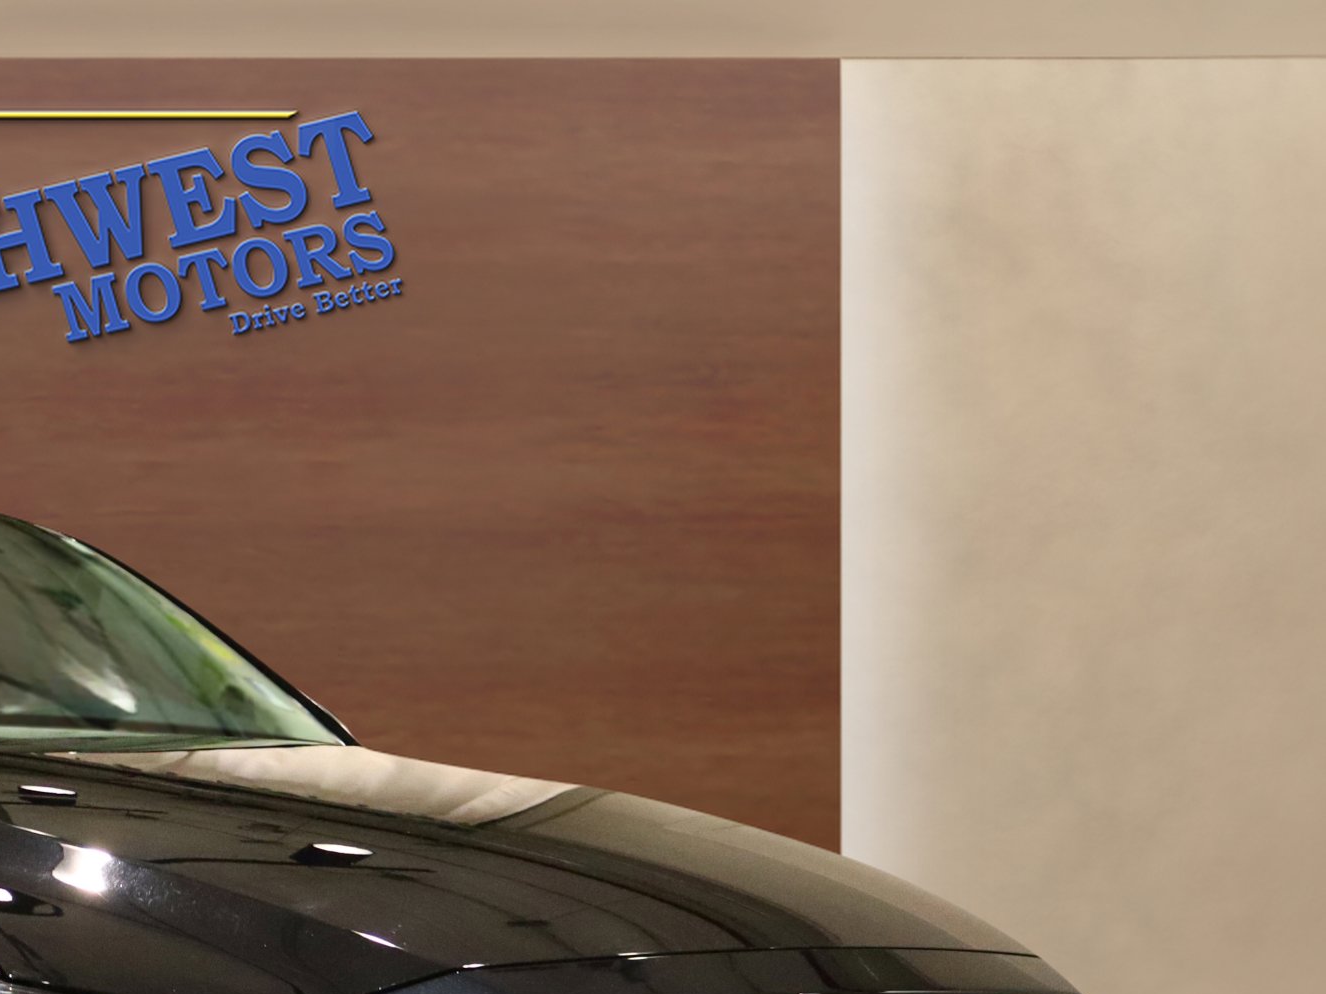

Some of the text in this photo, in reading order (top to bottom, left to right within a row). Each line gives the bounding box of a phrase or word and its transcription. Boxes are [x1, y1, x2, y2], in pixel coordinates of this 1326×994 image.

[53, 211, 396, 341] MOTORS
[229, 275, 404, 335] Drive Better
